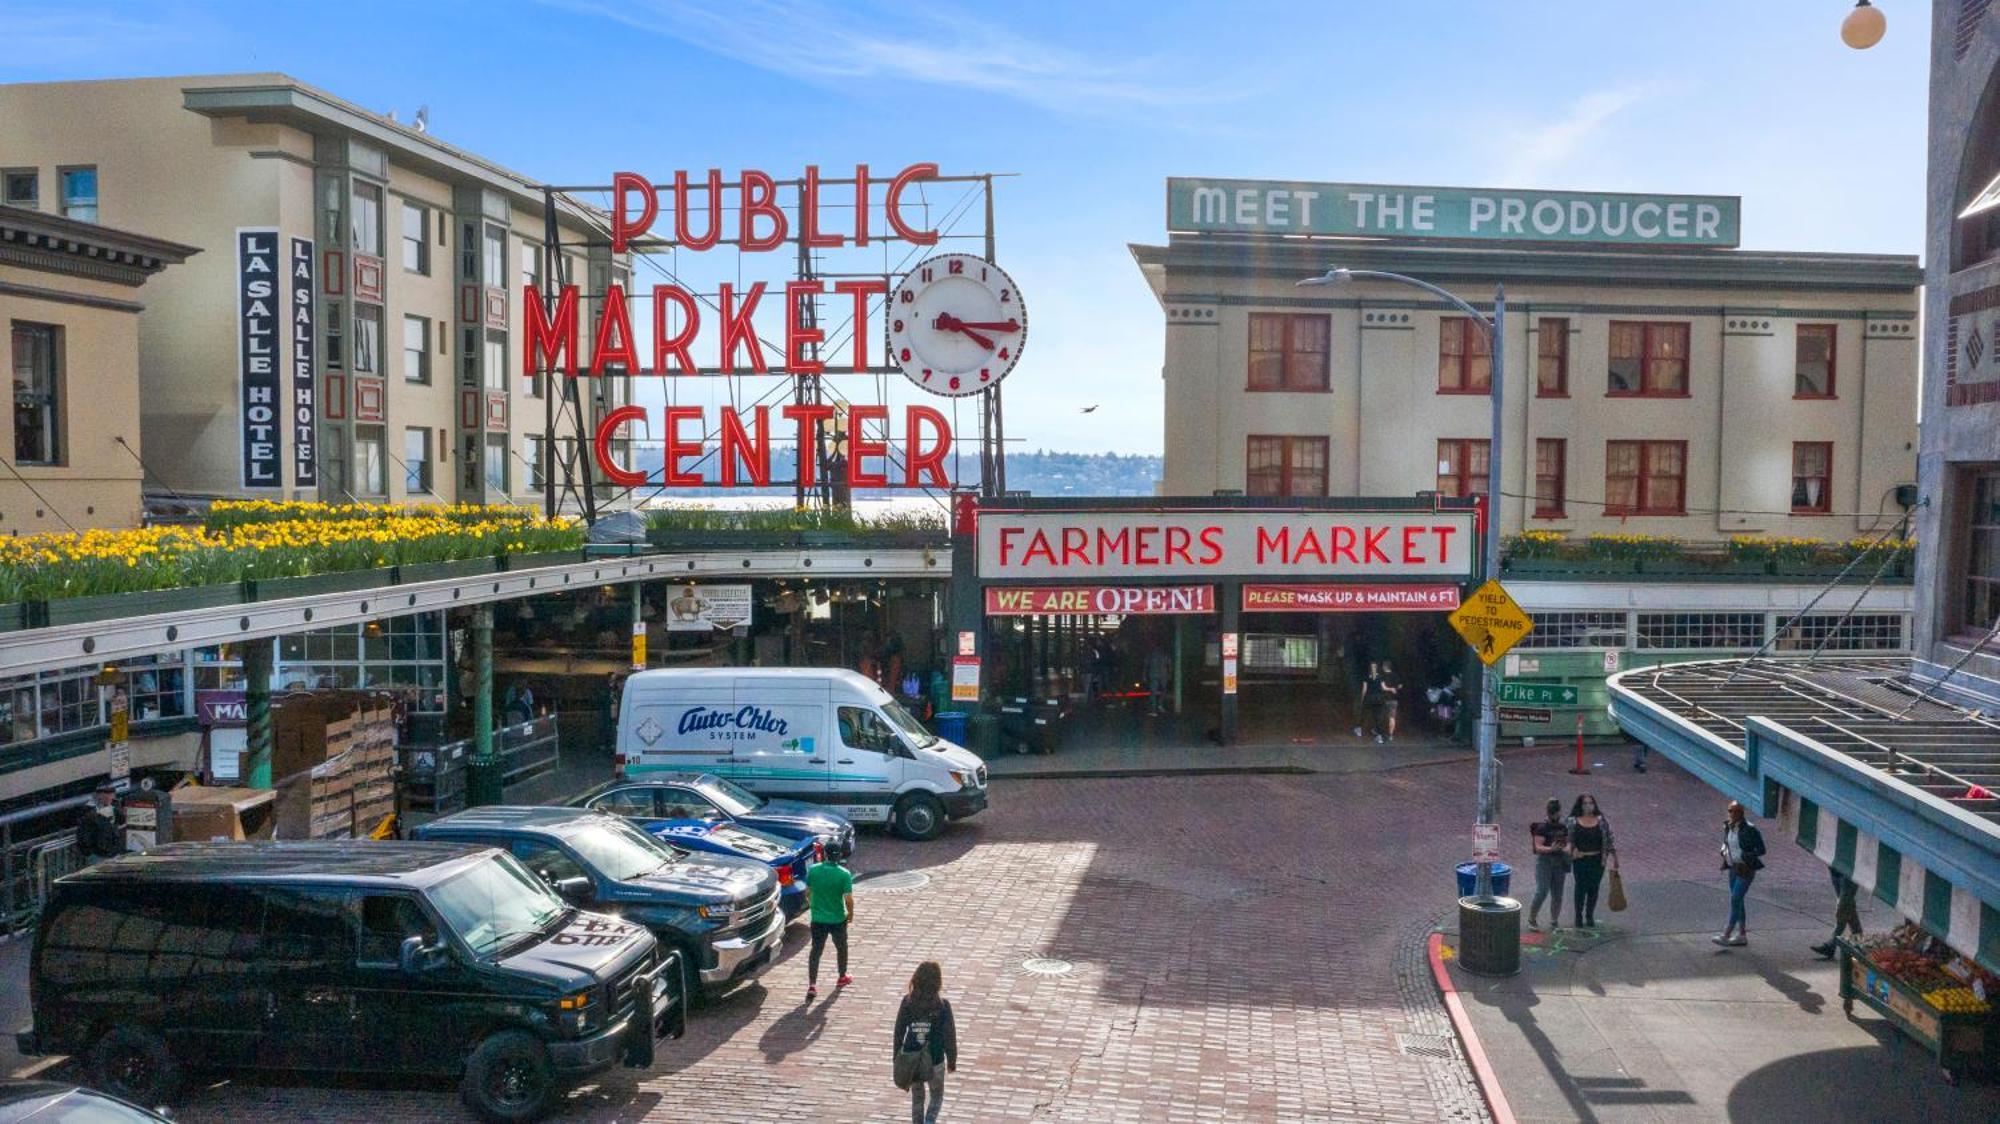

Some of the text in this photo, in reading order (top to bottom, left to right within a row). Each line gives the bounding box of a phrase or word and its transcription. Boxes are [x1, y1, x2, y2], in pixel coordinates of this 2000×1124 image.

[611, 162, 939, 254] PUBLIC
[1192, 186, 1721, 240] MEET THE PRODUCER
[949, 259, 964, 275] 12
[982, 267, 988, 282] 1
[922, 268, 933, 283] 11
[901, 290, 914, 303] 10
[1000, 288, 1010, 302] 2
[523, 280, 888, 378] MARKET
[893, 319, 904, 333] 9
[246, 237, 274, 480] LA SALLE HOTEL
[295, 241, 312, 479] LA SALLE HOTEL
[901, 347, 911, 362] 8
[998, 347, 1009, 361] 4
[921, 369, 932, 383] 7
[979, 368, 990, 382] 5
[949, 377, 960, 391] 6
[594, 405, 953, 489] CENTER
[999, 525, 1457, 566] FARMERS MARKET
[997, 588, 1204, 612] WE ARE OPEN!
[1249, 591, 1454, 604] PLEASE MASK UP & MAINTAIN 6 FT
[1478, 593, 1506, 605] YIELD
[1485, 605, 1497, 615] TO
[1459, 616, 1523, 631] PEDESTRIANS
[1504, 686, 1553, 700] Pike Pl
[678, 706, 788, 736] Auto-Chlor
[710, 731, 757, 740] SYSTEM
